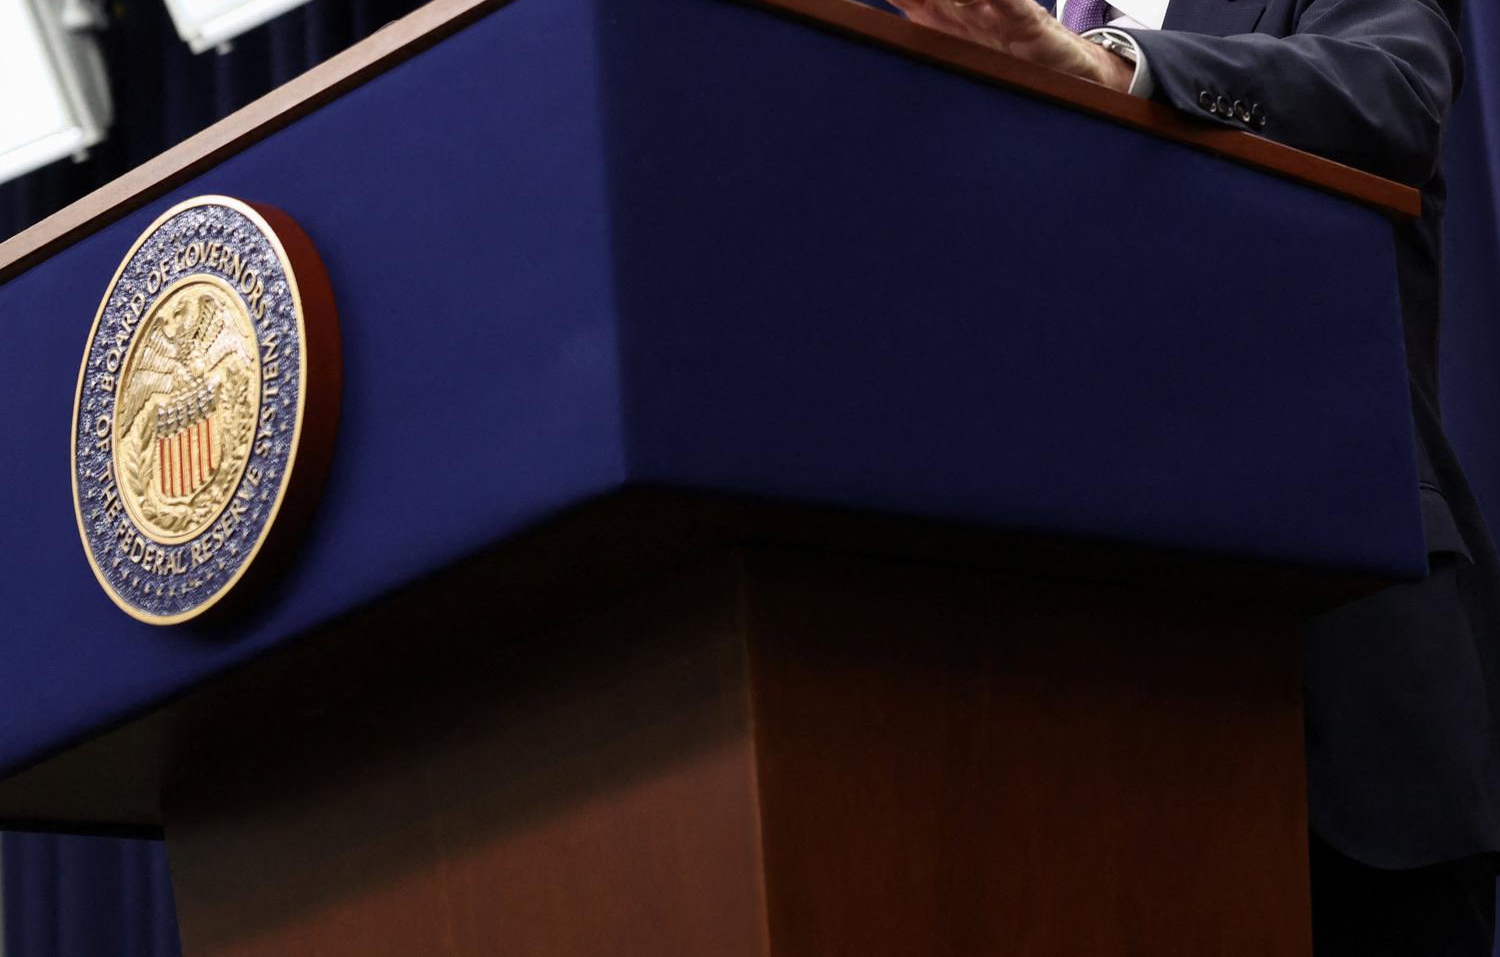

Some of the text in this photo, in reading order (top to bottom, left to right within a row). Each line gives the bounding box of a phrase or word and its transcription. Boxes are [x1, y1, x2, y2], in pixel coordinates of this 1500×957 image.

[102, 242, 267, 392] BOARD OF GOVERNORS
[96, 333, 280, 575] OF THE FEDERAL RESERVE SYSTEM
